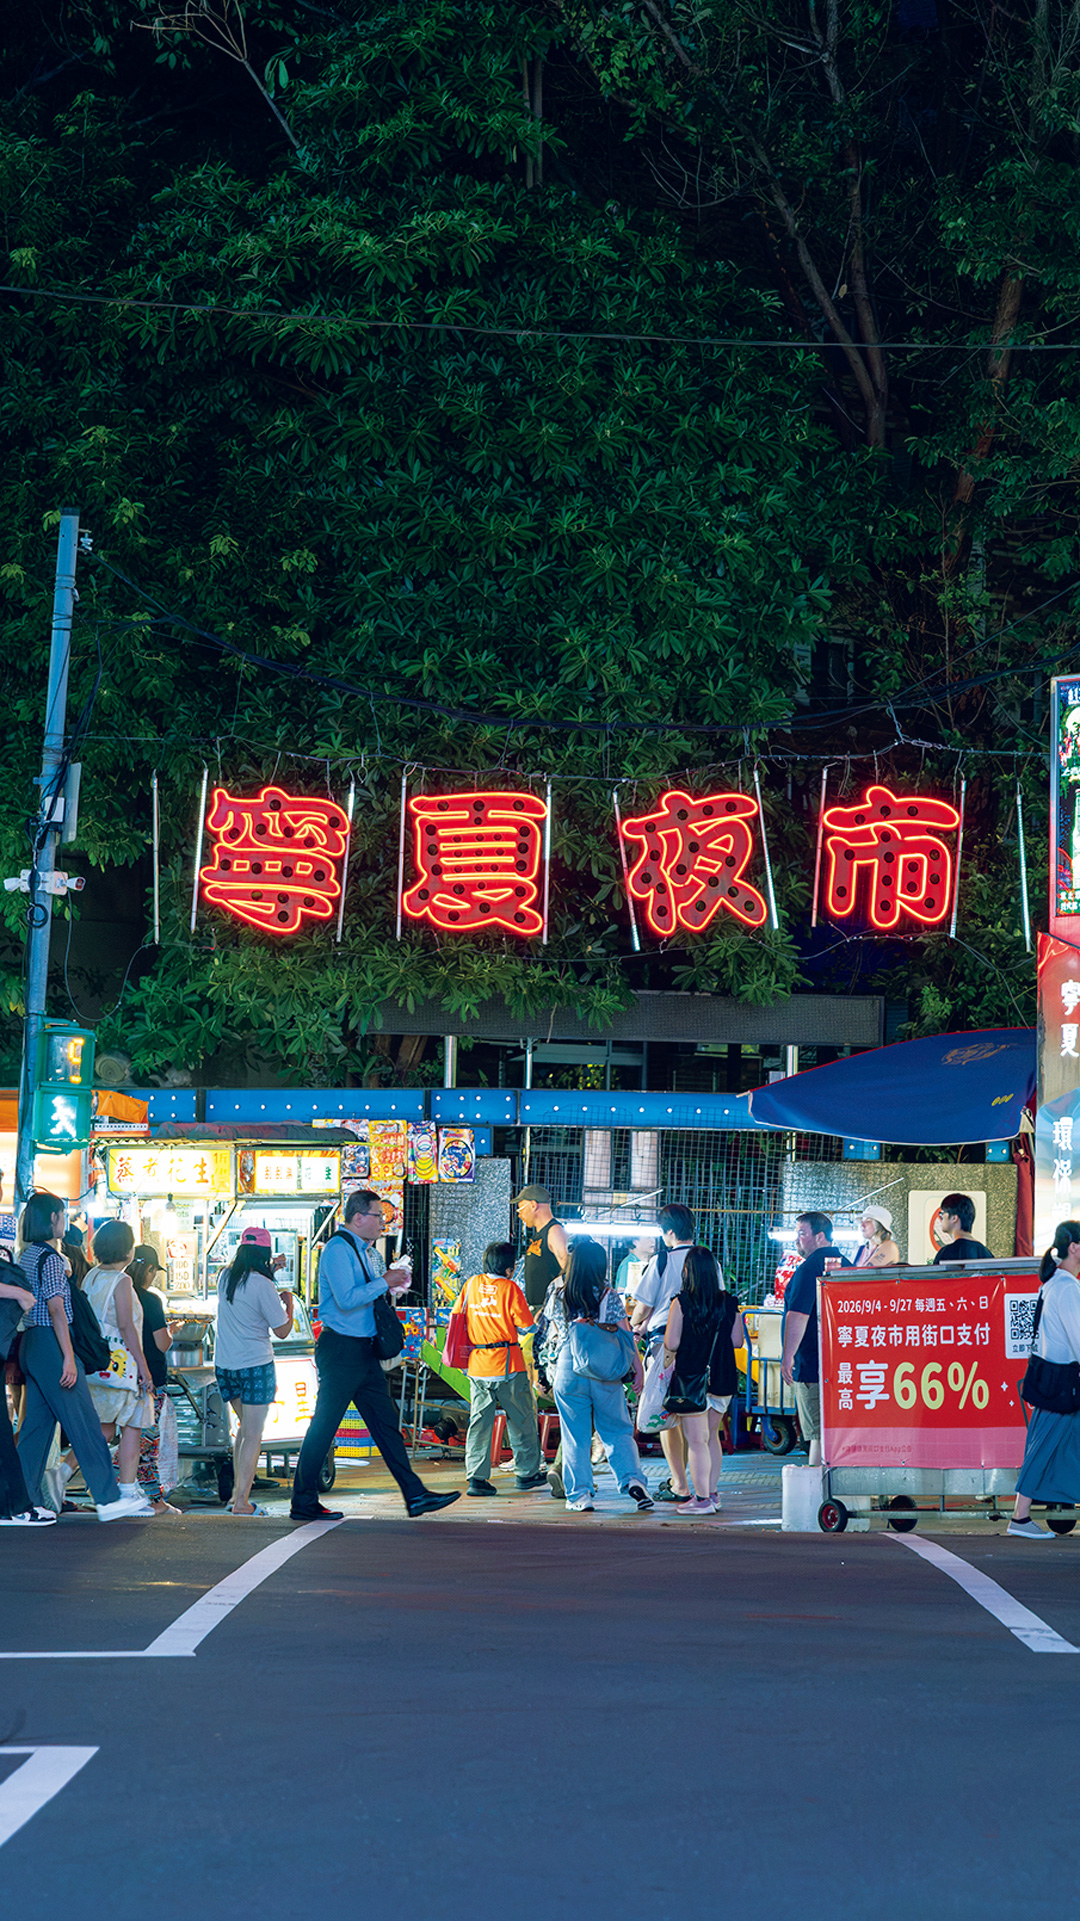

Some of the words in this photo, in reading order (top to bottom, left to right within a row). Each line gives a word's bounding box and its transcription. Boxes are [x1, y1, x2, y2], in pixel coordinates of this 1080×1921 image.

[200, 785, 960, 935] 寧夏夜市
[837, 1300, 881, 1315] 2026/9/4
[890, 1299, 913, 1314] 9/27
[914, 1296, 989, 1313] 每週五、六、日
[837, 1322, 991, 1348] 寧夏夜市用街口支付
[837, 1362, 854, 1411] 最高
